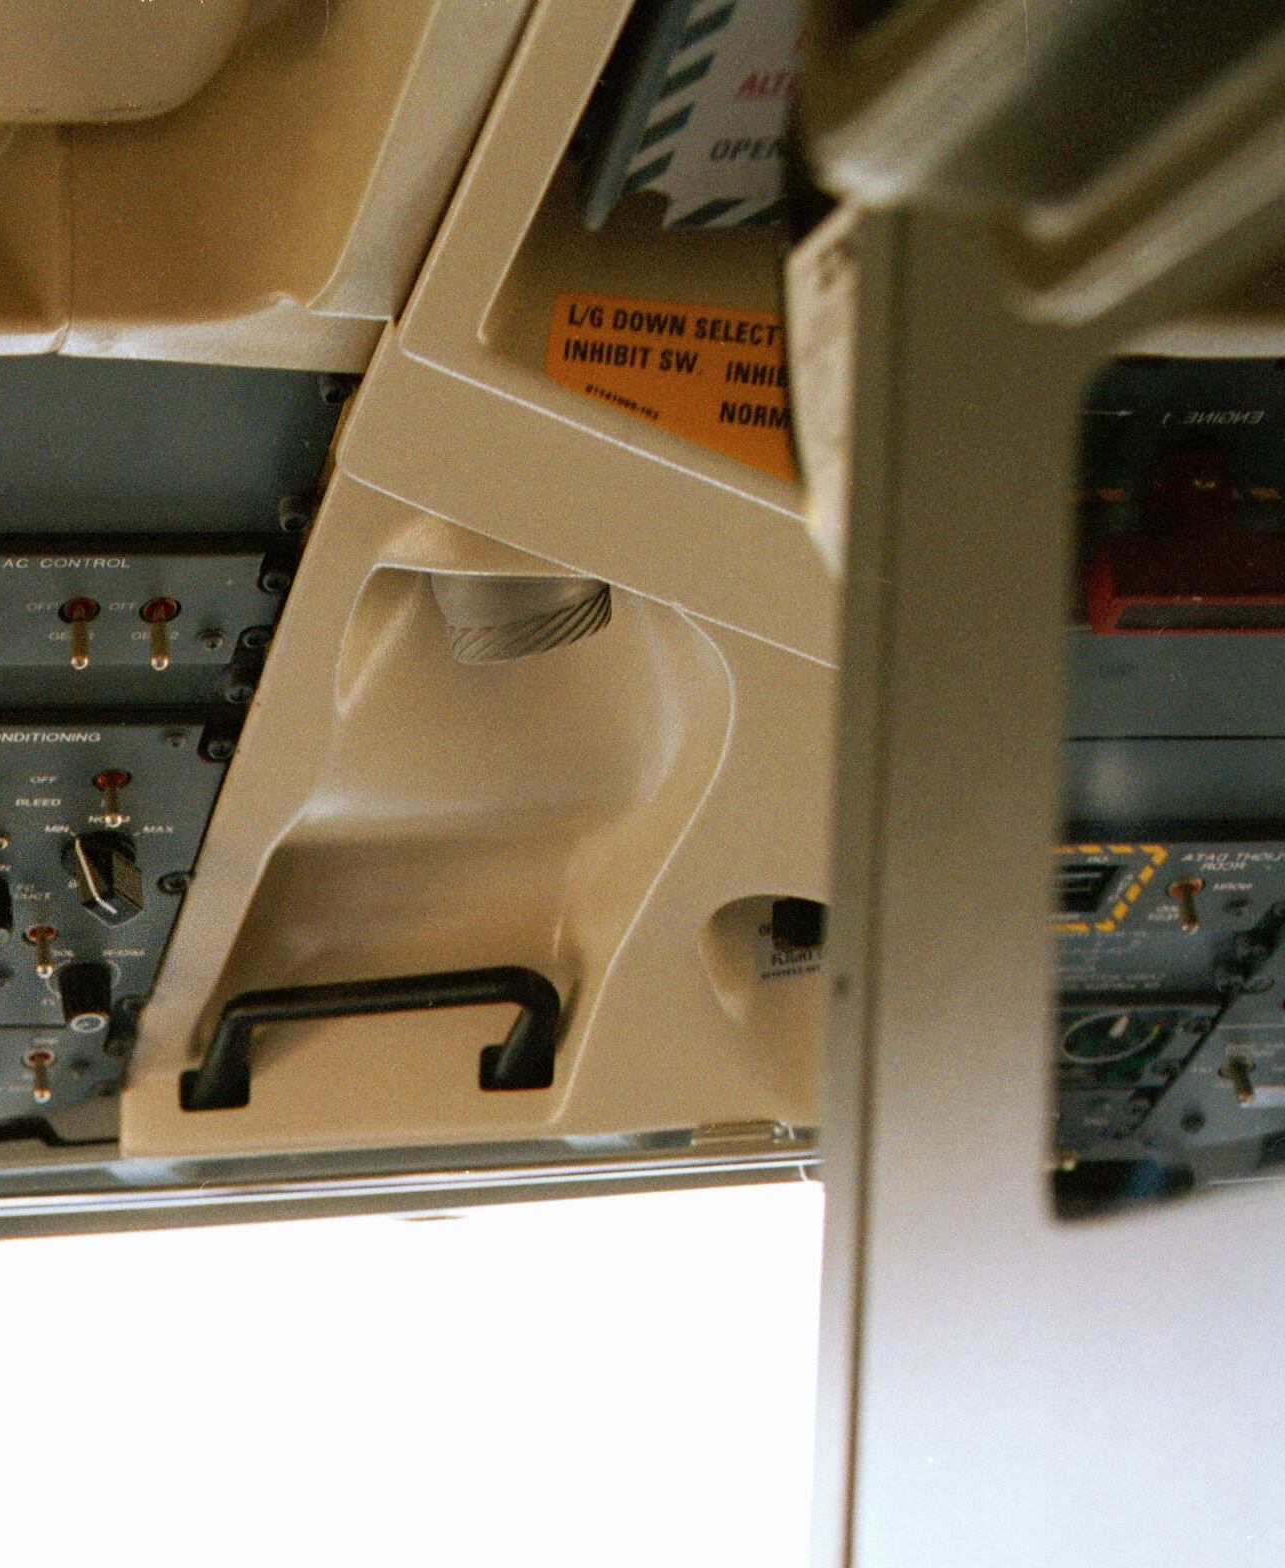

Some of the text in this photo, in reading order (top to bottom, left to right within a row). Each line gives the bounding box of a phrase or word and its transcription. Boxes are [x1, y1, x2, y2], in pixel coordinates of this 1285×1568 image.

[568, 303, 783, 348] L/G DOWN SELECT
[563, 338, 653, 370] INHIBIT
[1, 558, 132, 569] AC CONTROL
[15, 798, 62, 808] BLEED
[142, 824, 175, 834] MAX
